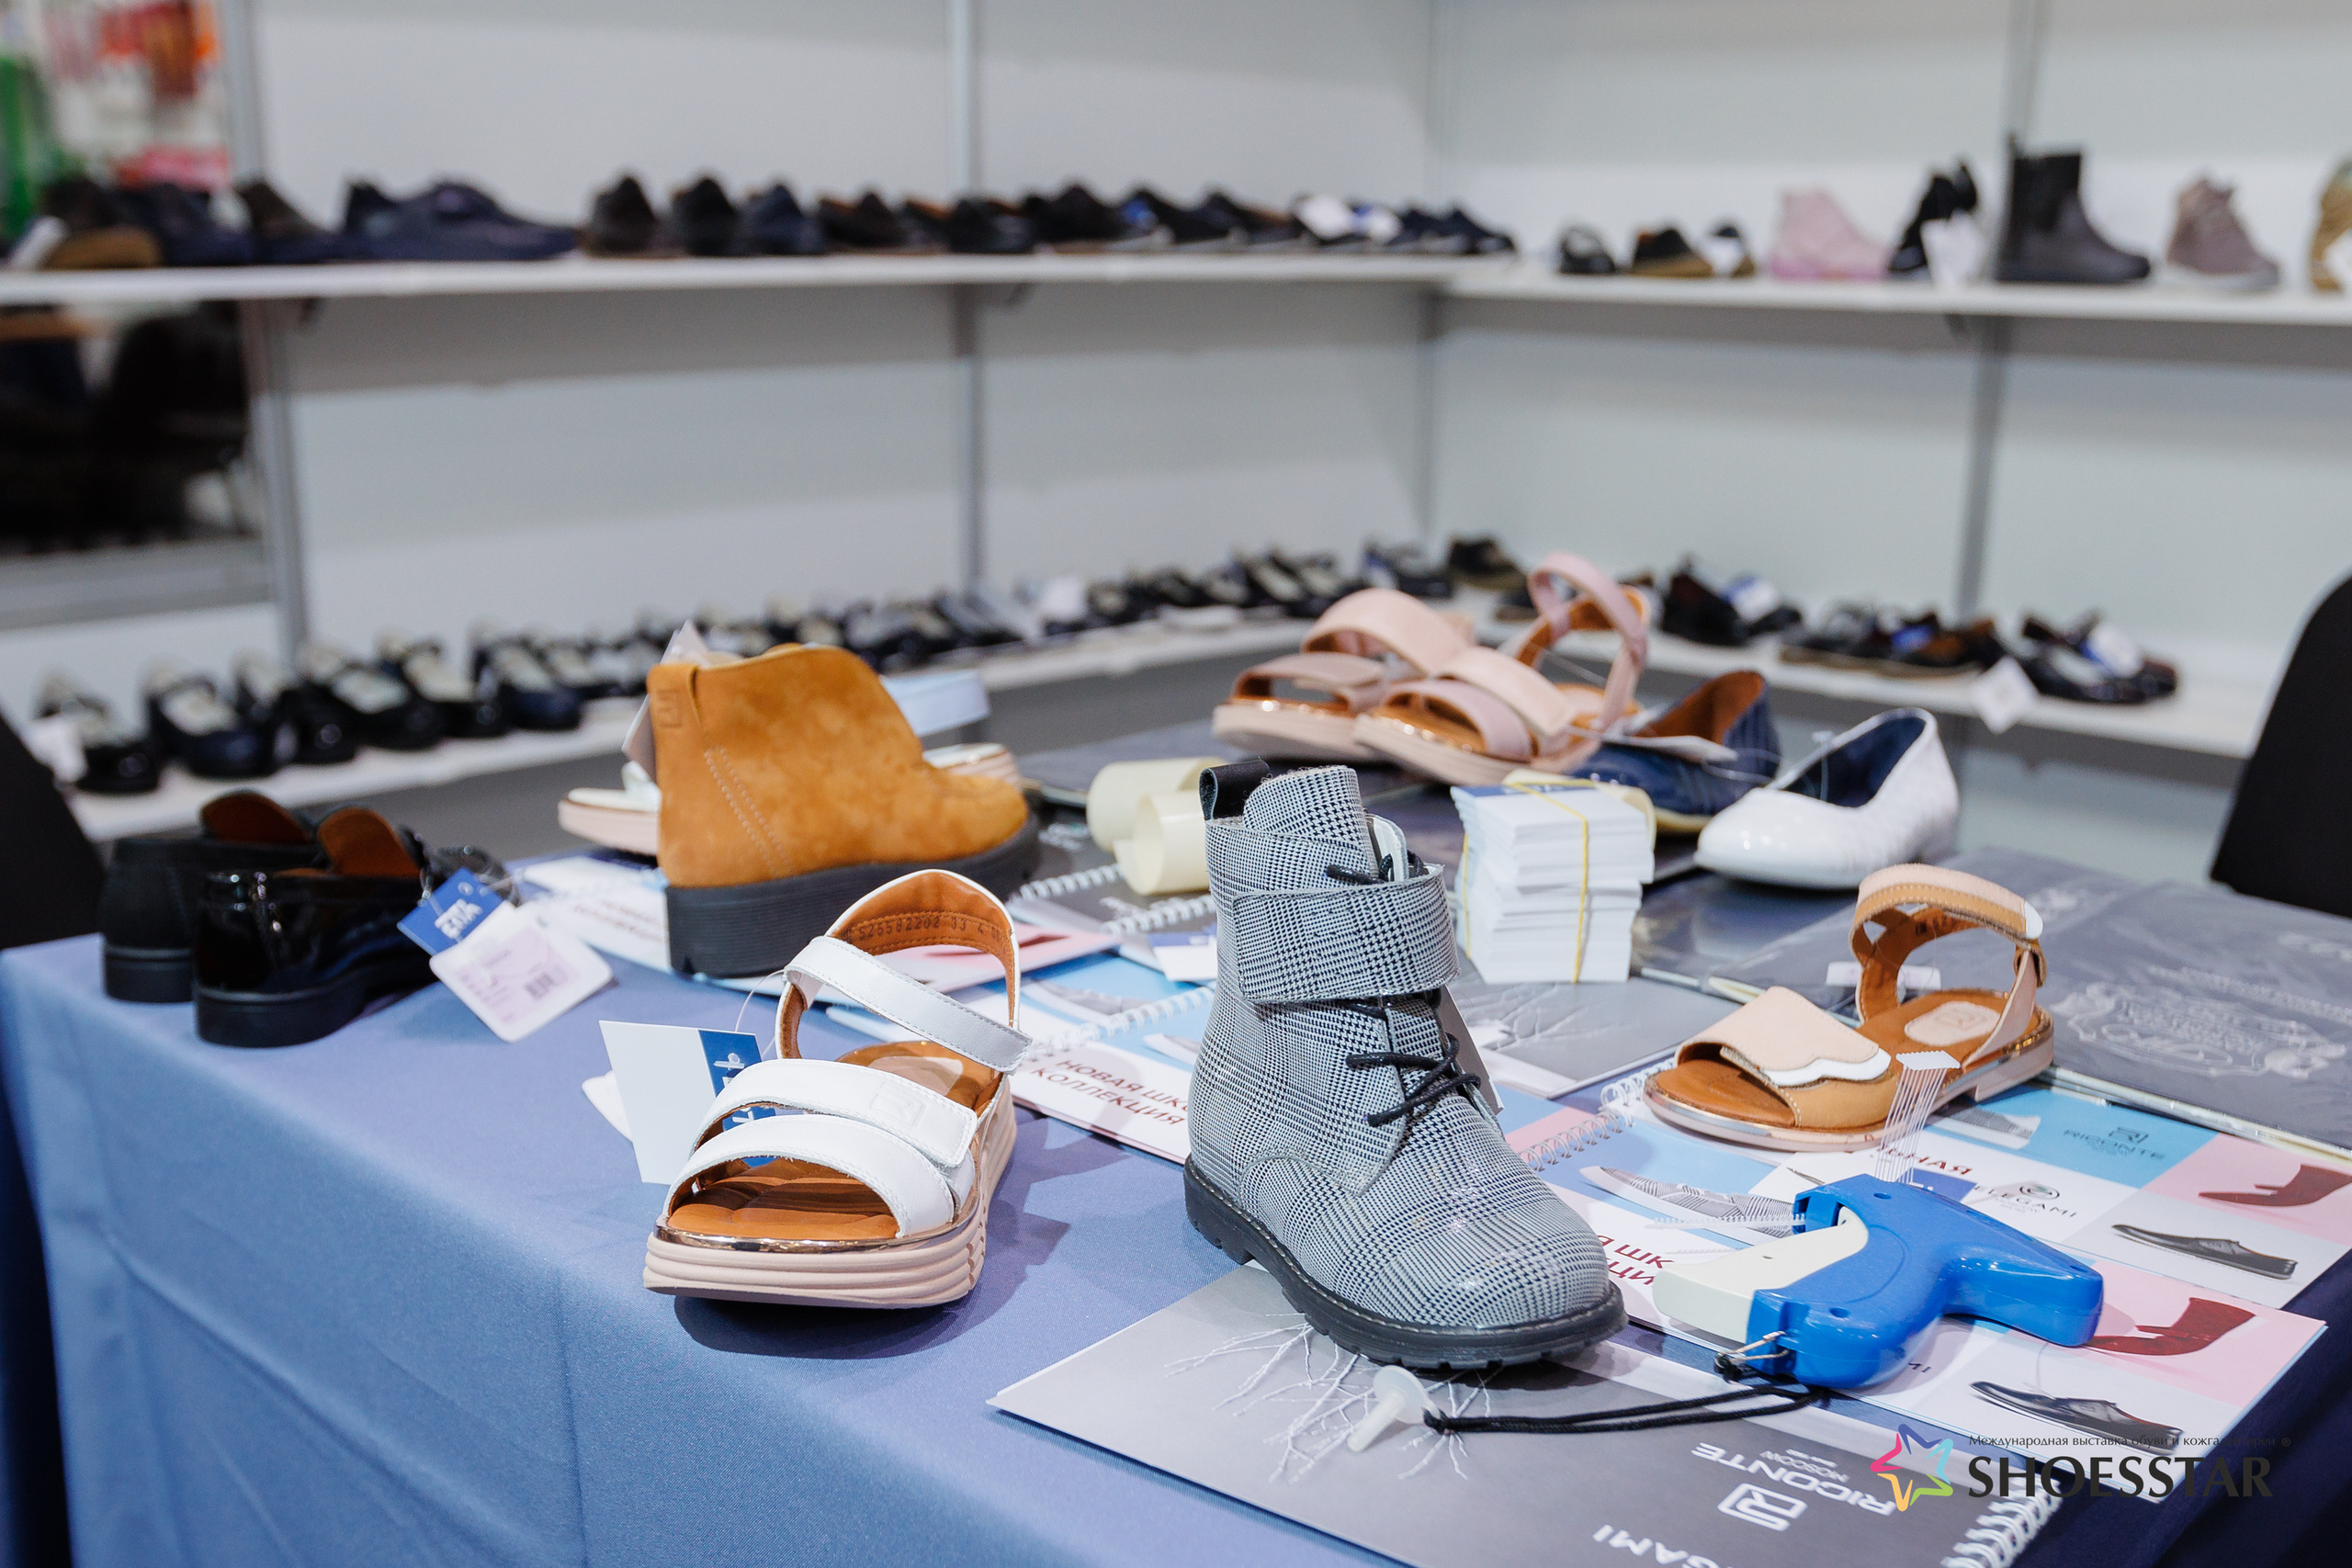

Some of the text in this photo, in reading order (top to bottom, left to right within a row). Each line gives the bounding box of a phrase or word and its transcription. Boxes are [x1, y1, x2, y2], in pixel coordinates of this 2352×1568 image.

[1032, 1067, 1185, 1125] КОЛЛЕКЦИЯ
[1057, 1059, 1188, 1112] НОВАЯ ШК
[1690, 1442, 1897, 1516] RICONTE
[1759, 1450, 1850, 1483] MOSCOW
